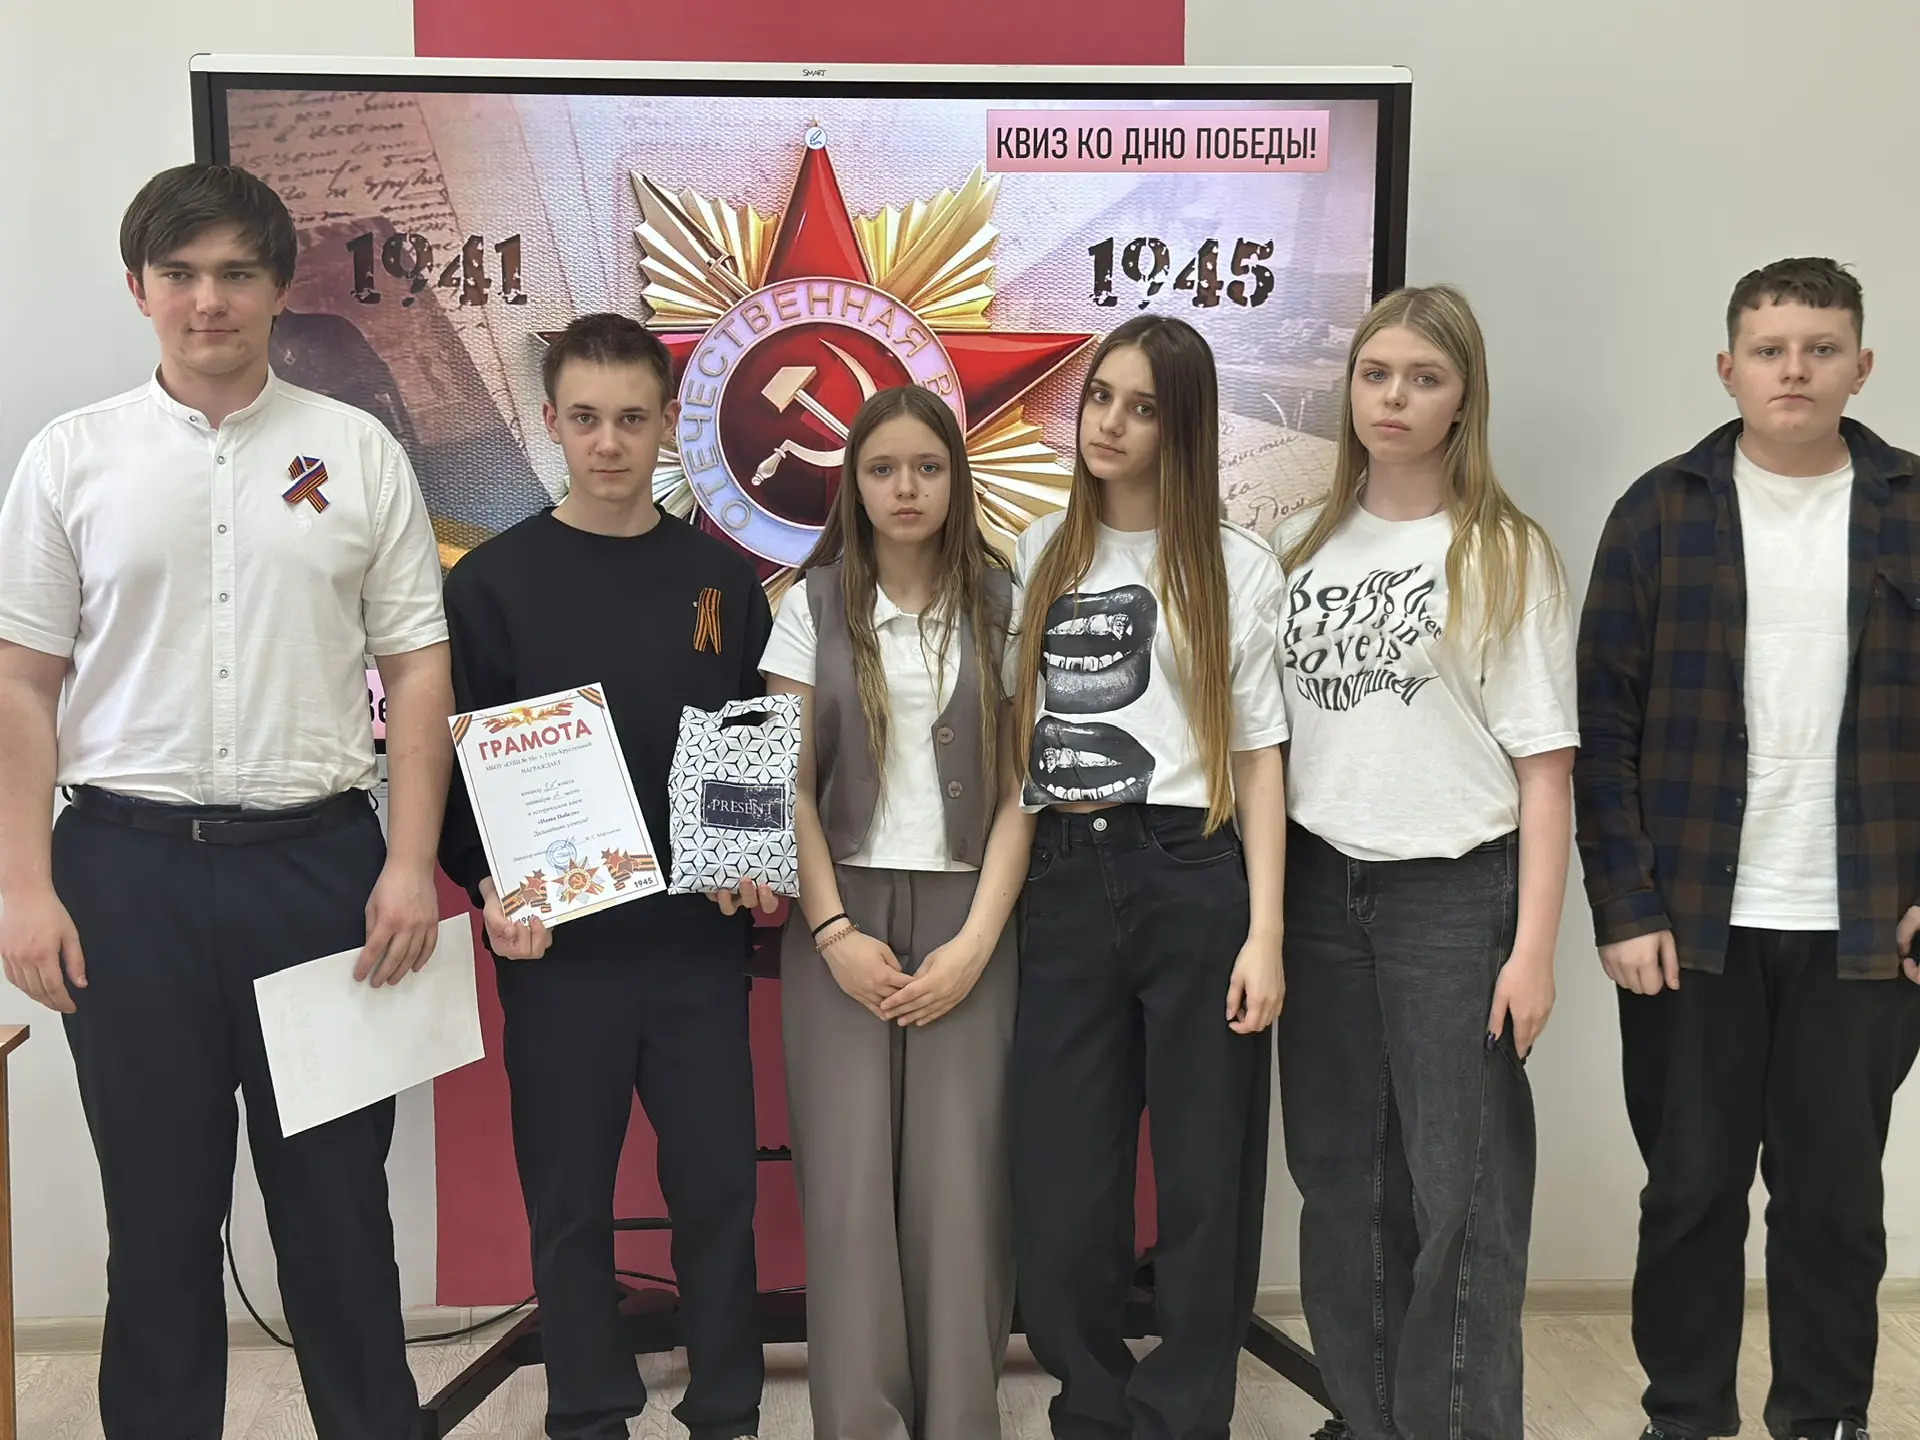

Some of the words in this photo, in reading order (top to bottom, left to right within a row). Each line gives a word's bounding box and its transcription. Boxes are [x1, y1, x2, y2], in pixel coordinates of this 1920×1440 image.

[802, 69, 827, 77] SMART
[996, 127, 1068, 159] КВИЗ
[1077, 127, 1112, 159] КО
[1121, 127, 1186, 166] ДНЮ
[1195, 127, 1317, 166] ПОБЕДЫ!
[345, 231, 528, 308] 1941
[1088, 236, 1275, 311] 1945
[683, 284, 931, 530] ОТЕЧЕСТВЕННАЯ
[1375, 631, 1402, 661] is
[478, 718, 593, 761] ГРАМОТА
[711, 798, 773, 816] PRESENT
[634, 877, 653, 889] 1945
